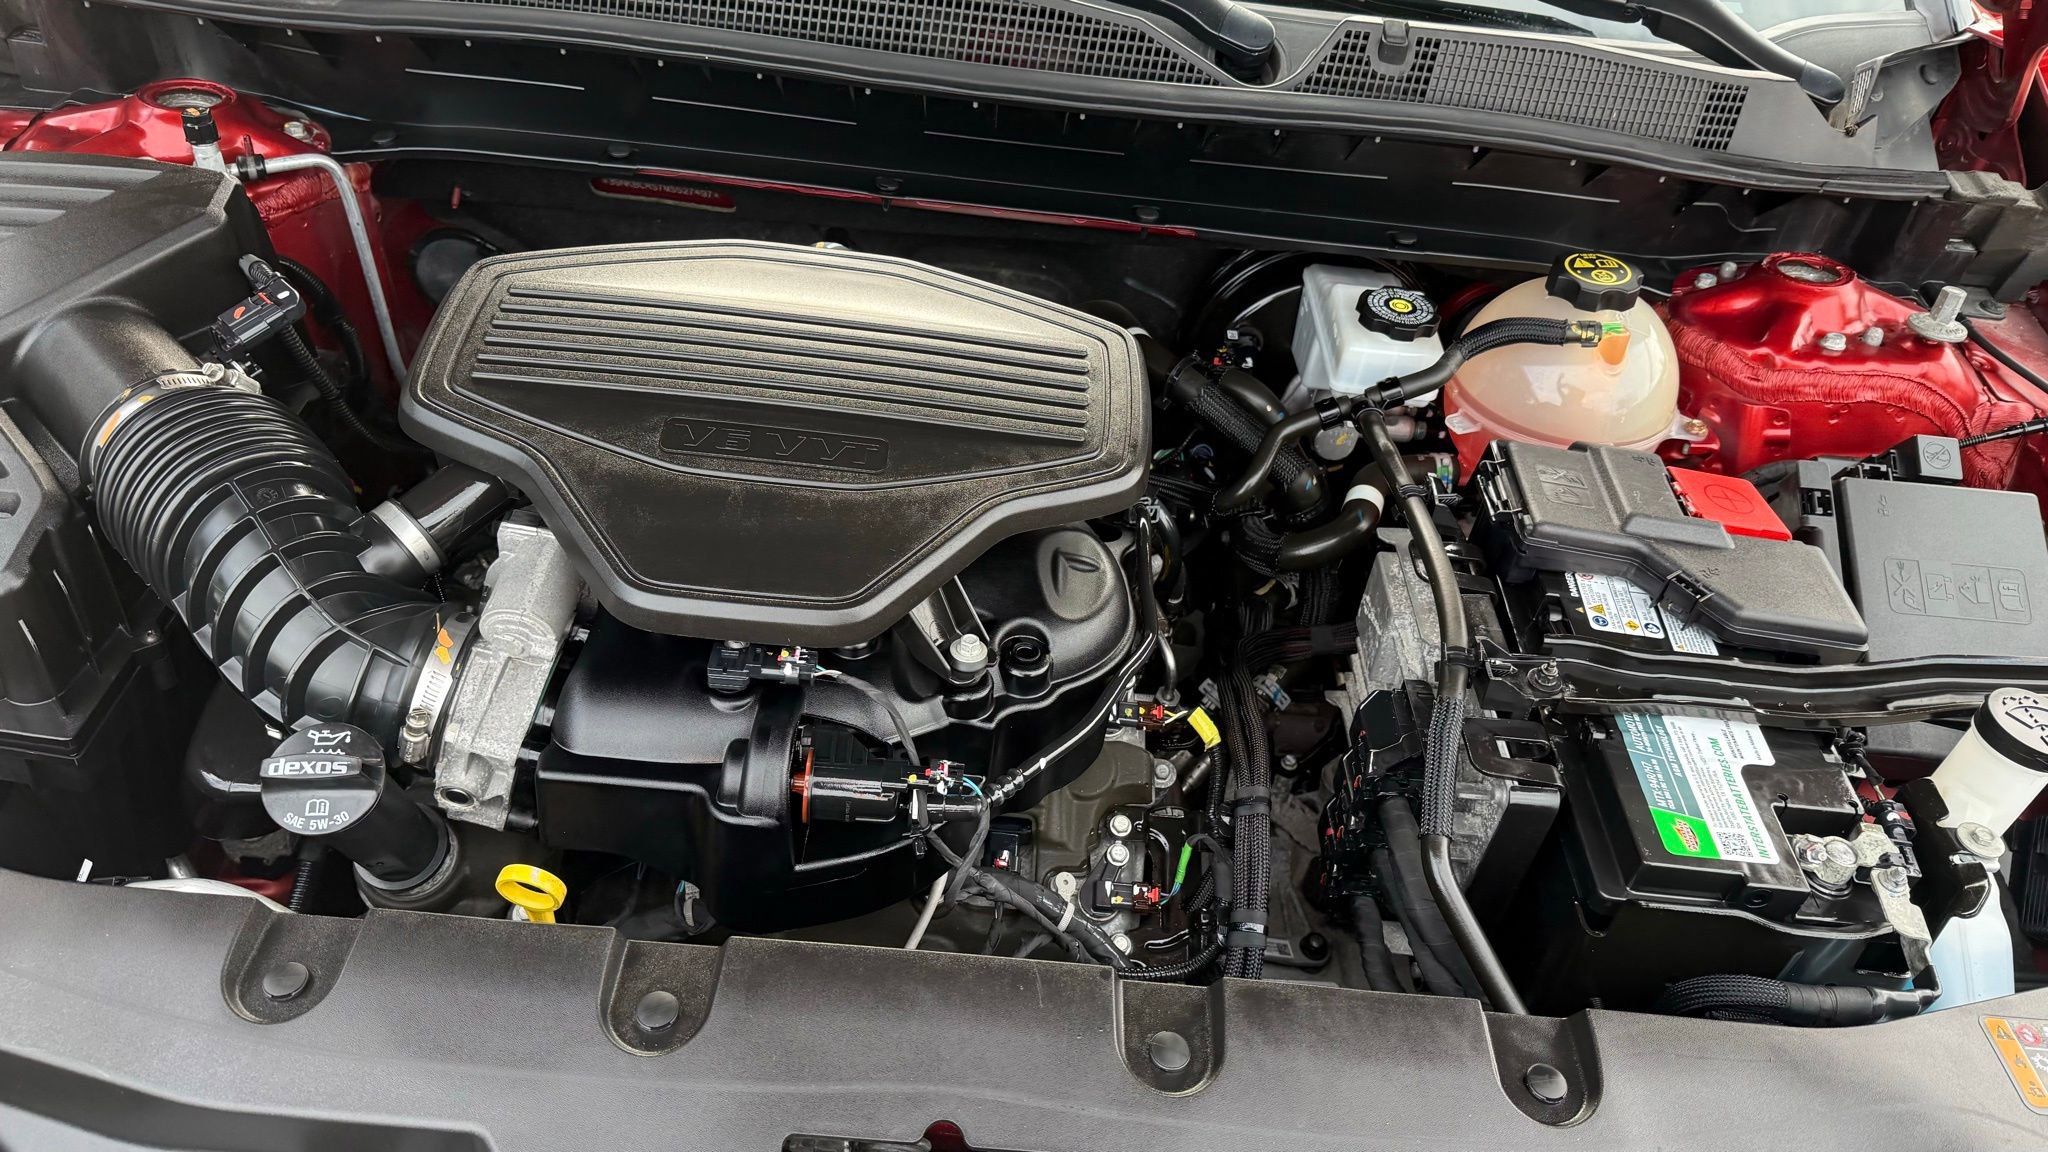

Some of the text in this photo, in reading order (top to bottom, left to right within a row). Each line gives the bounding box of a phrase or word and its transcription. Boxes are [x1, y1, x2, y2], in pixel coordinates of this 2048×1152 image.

[673, 423, 751, 452] V6
[267, 758, 348, 776] dexos
[1707, 736, 1771, 860] INTERSTATEBATTERIES.COM
[283, 811, 350, 831] SAE 5W-30
